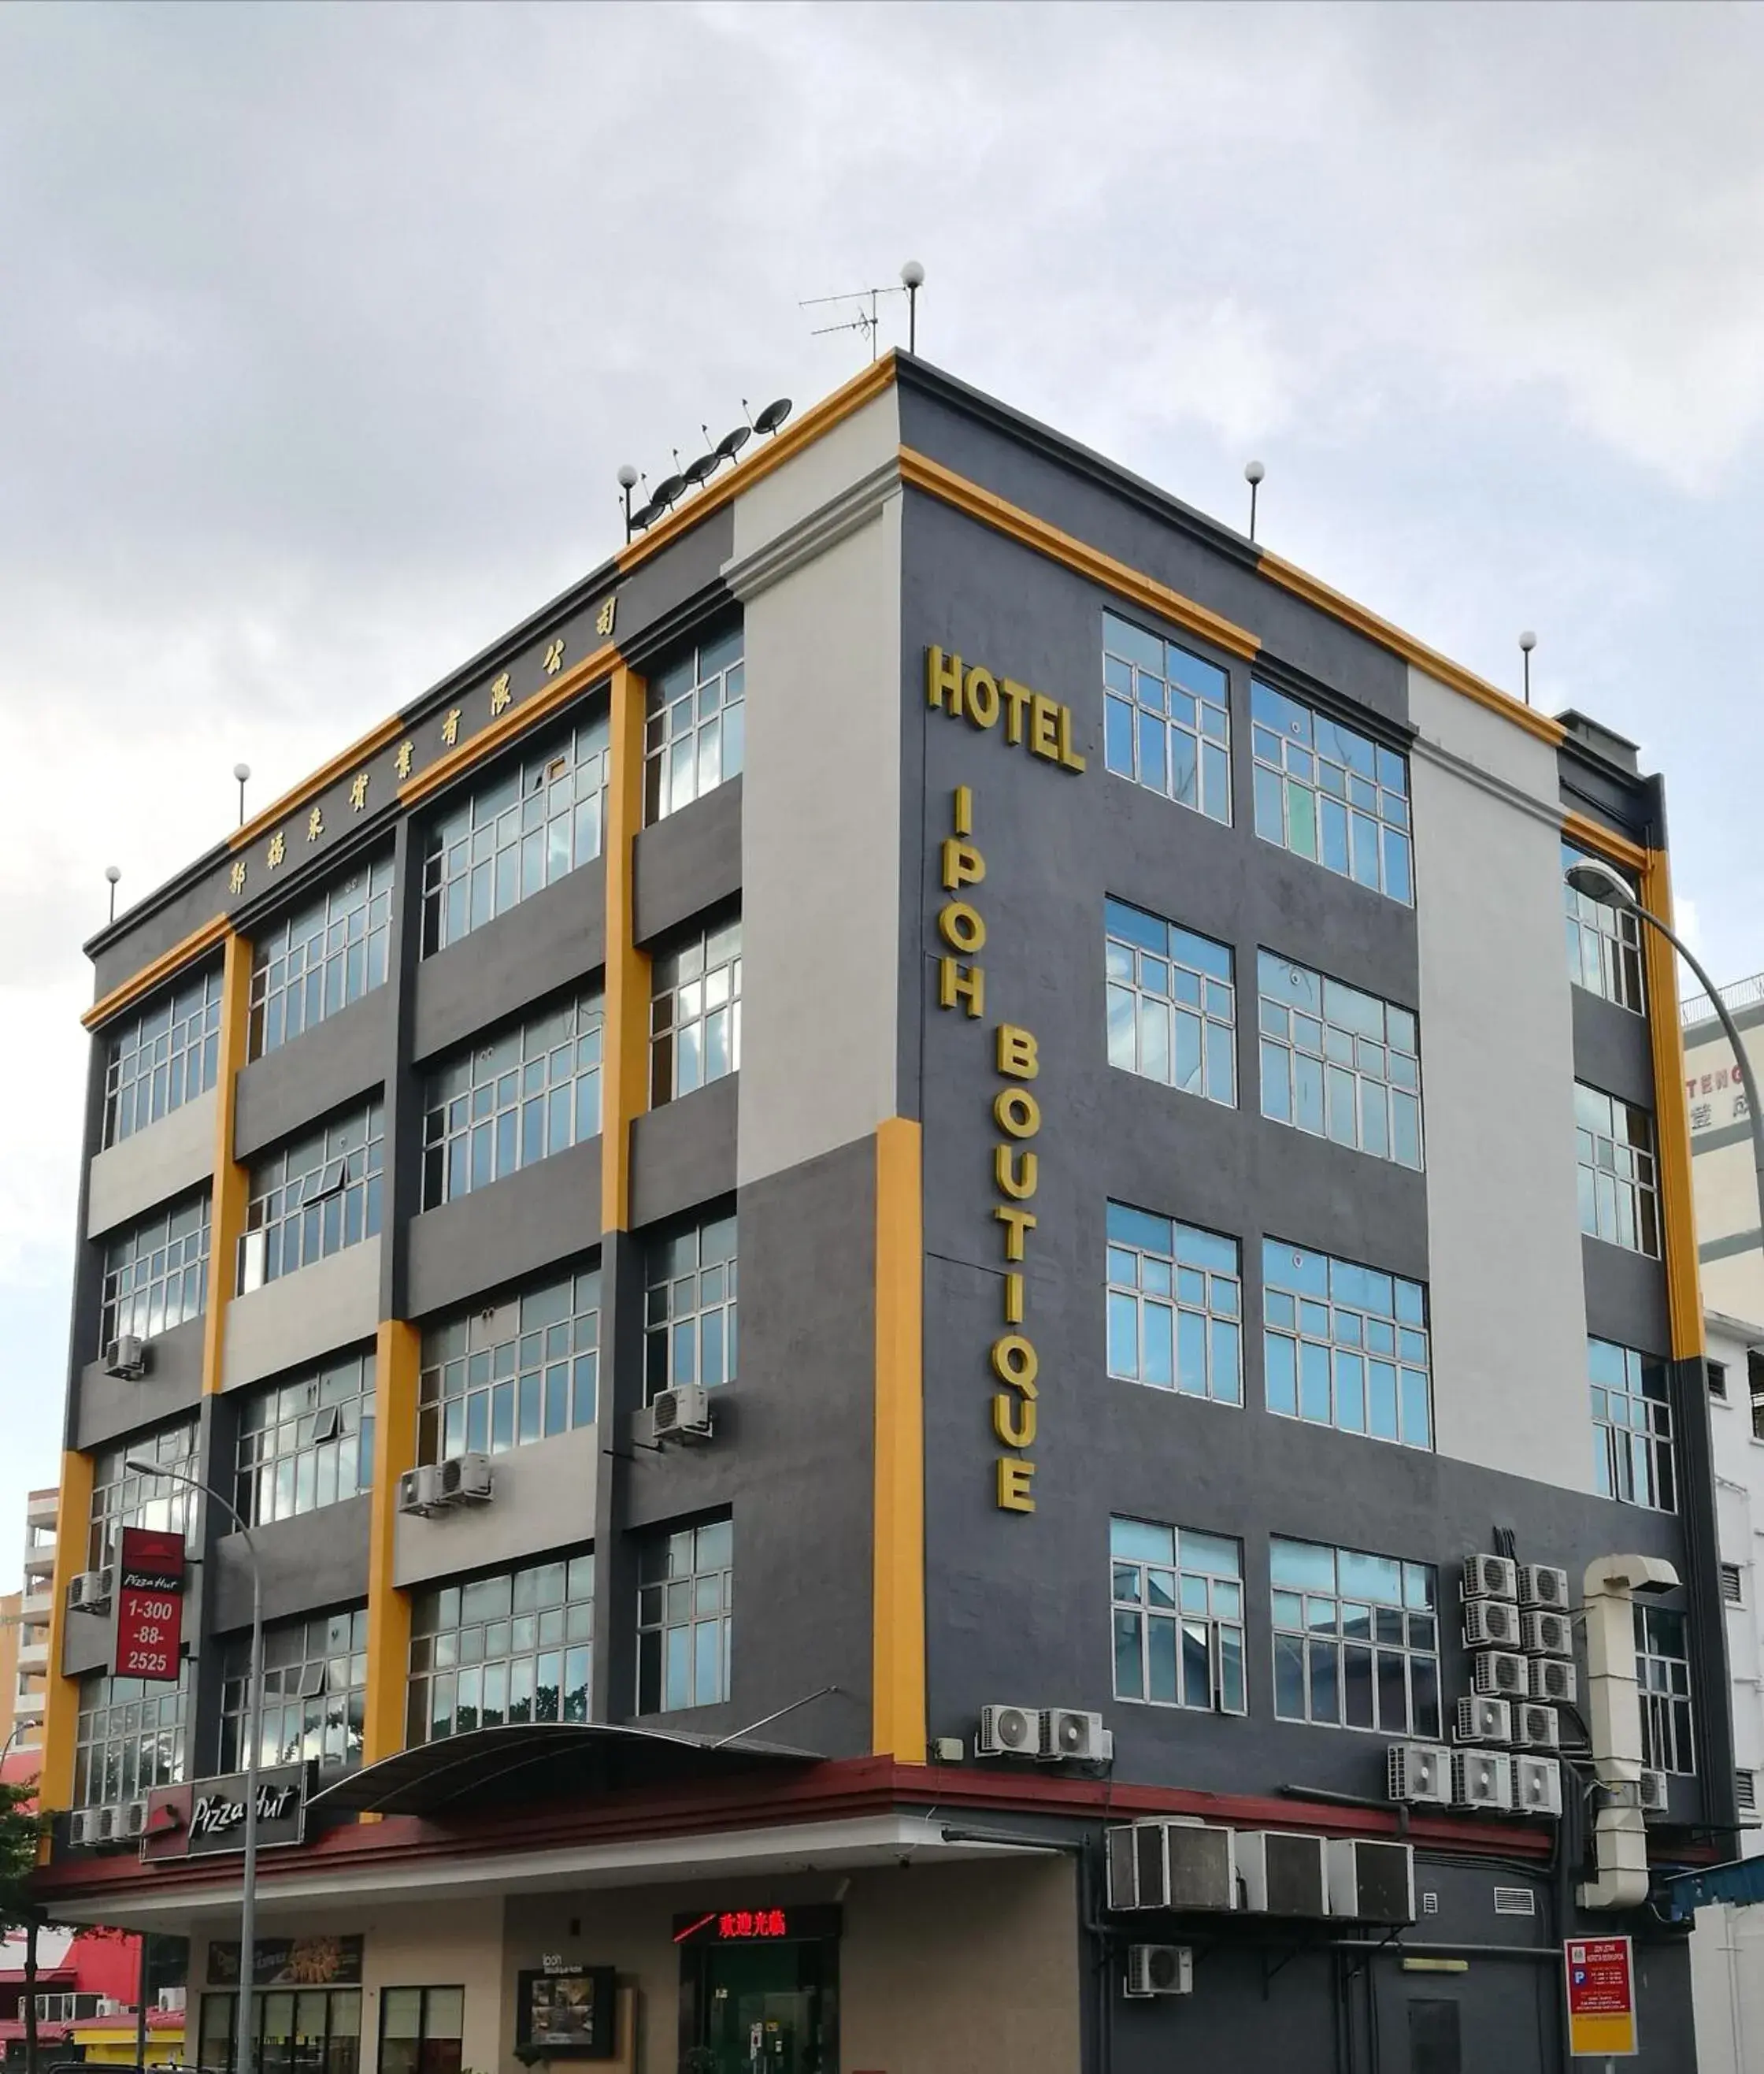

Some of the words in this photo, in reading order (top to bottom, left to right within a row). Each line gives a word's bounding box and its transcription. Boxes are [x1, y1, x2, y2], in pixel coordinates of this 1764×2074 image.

[927, 644, 1086, 775] HOTEL
[939, 785, 986, 1018] IPOH
[991, 1023, 1041, 1512] BOUTIQUE
[124, 1574, 153, 1588] Pizza
[154, 1577, 177, 1589] Hut
[129, 1599, 172, 1620] 1-300
[133, 1626, 165, 1644] -88-
[128, 1651, 167, 1671] 2525
[188, 1796, 244, 1838] Pizza
